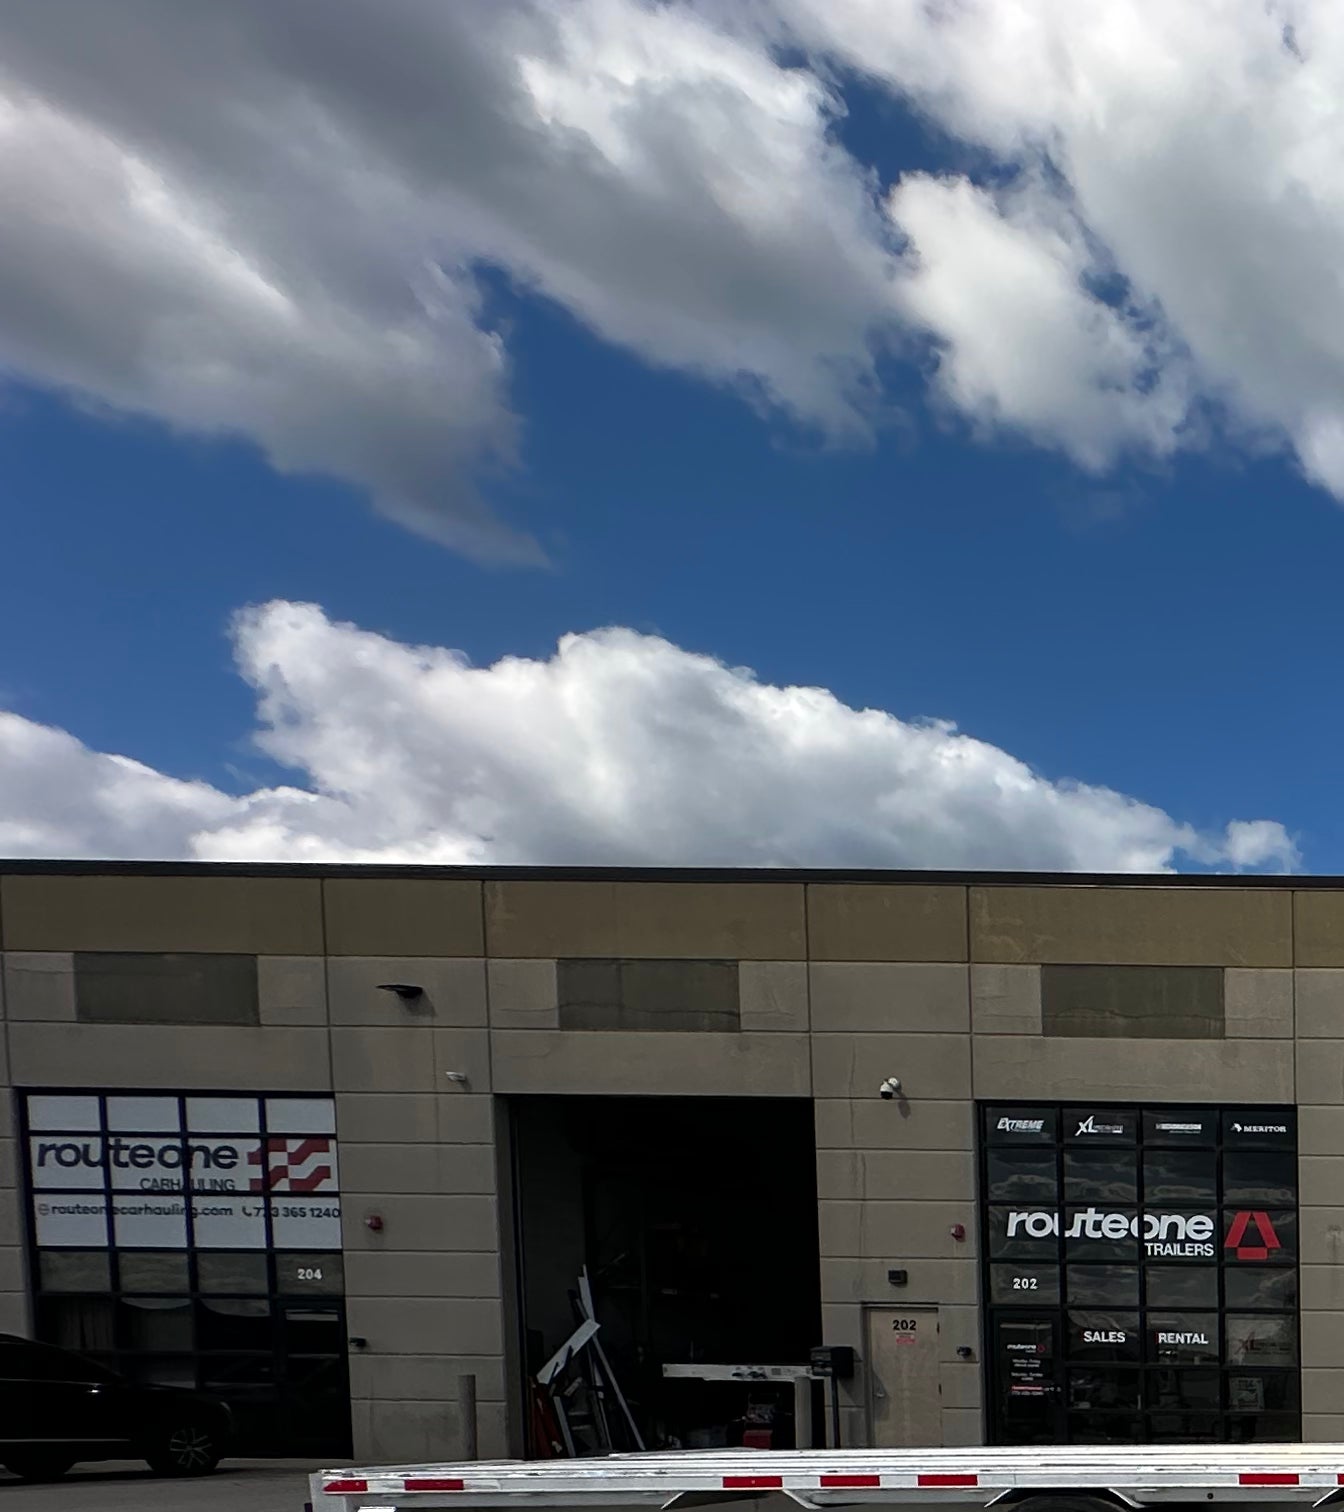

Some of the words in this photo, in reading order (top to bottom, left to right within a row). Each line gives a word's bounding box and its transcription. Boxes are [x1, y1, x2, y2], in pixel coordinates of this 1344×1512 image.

[37, 1138, 239, 1169] routeone
[140, 1178, 235, 1191] CARHULING
[1007, 1208, 1214, 1241] routeone
[1144, 1243, 1214, 1257] TRAILERS
[297, 1269, 322, 1280] 204
[1013, 1278, 1038, 1290] 202
[893, 1319, 917, 1331] 202
[1083, 1331, 1126, 1343] SALES
[1158, 1332, 1209, 1345] RENTAL
